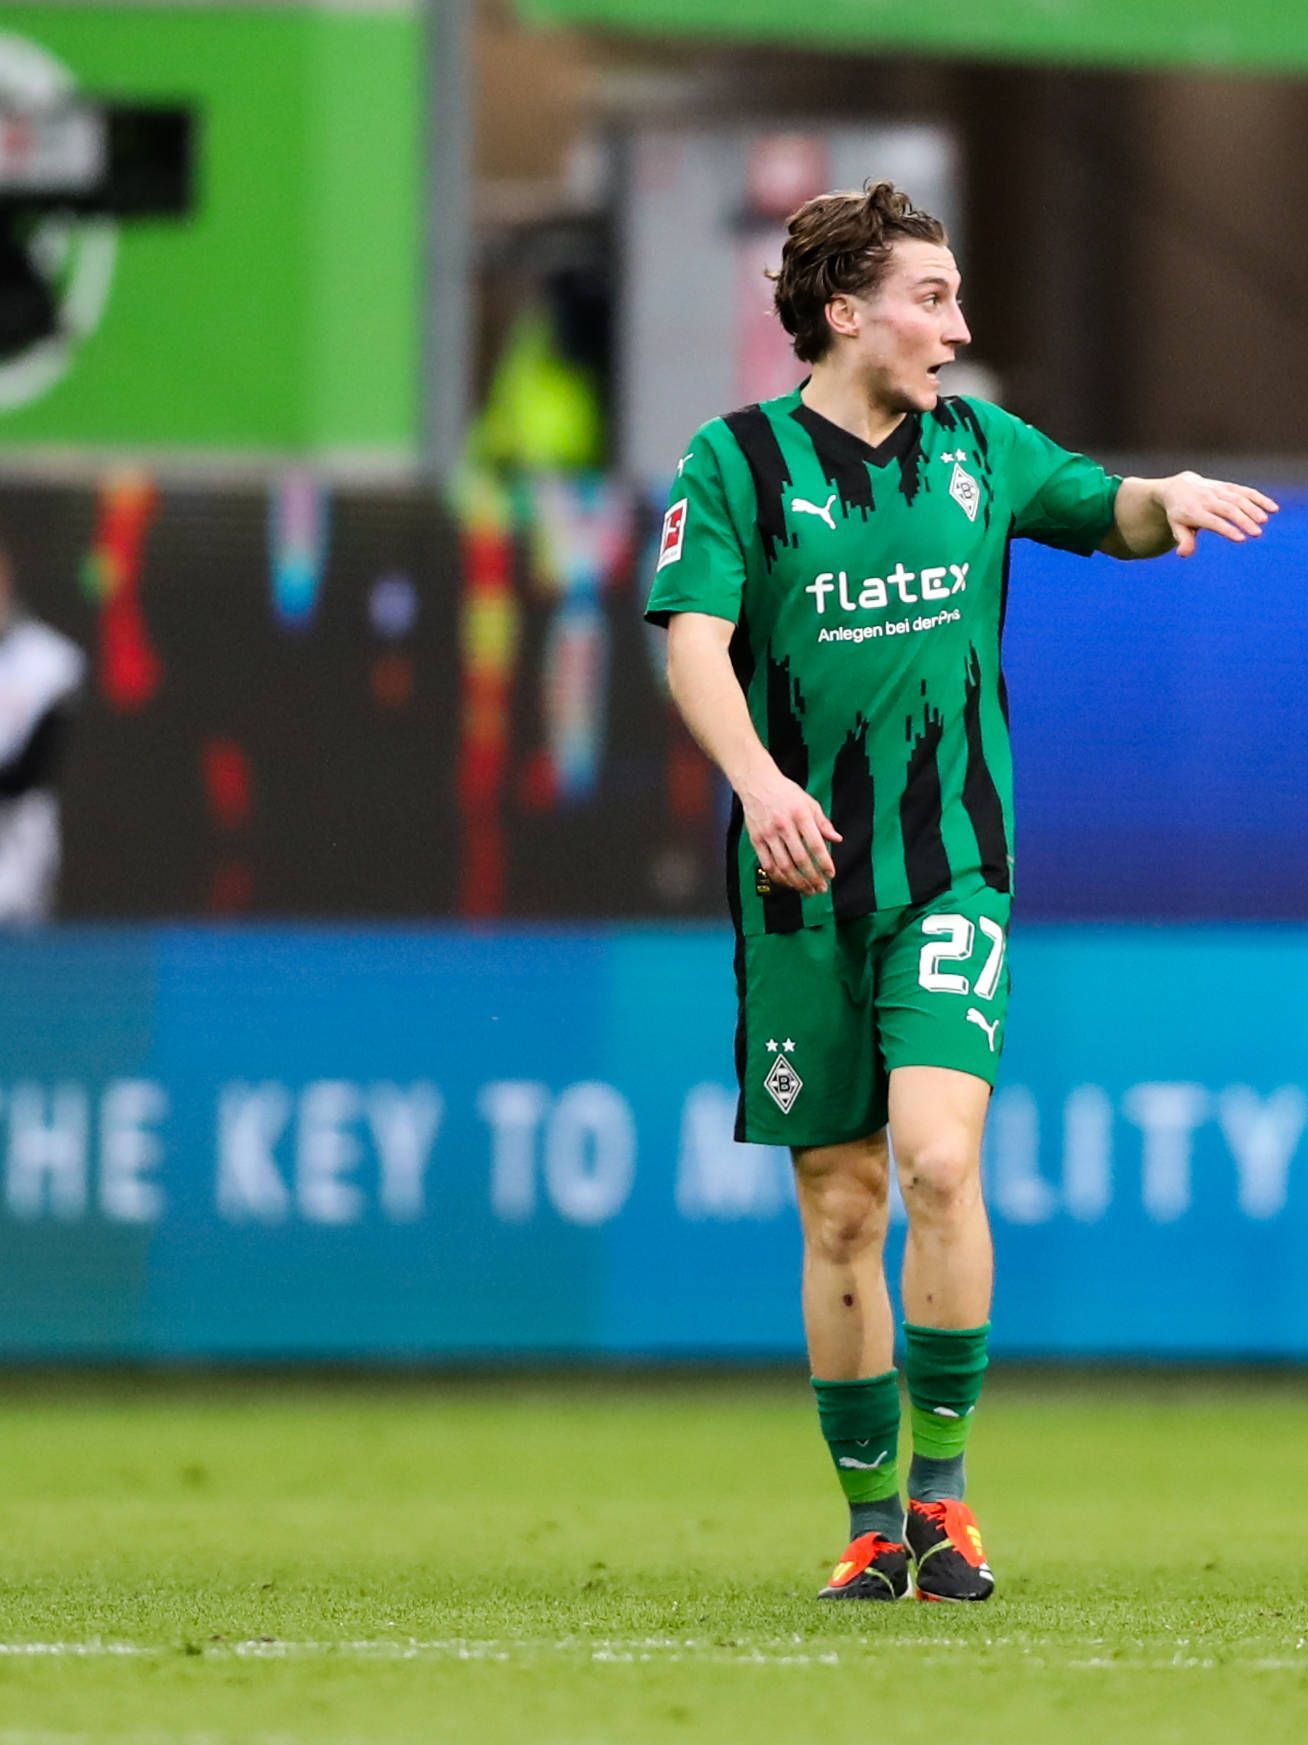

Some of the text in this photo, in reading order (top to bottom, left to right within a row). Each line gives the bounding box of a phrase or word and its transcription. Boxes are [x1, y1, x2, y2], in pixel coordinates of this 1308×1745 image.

[818, 626, 883, 643] Anlegen
[885, 618, 910, 636] bei
[918, 913, 1006, 1000] 27
[0, 1078, 1308, 1226] HE KEY TO MLITY
